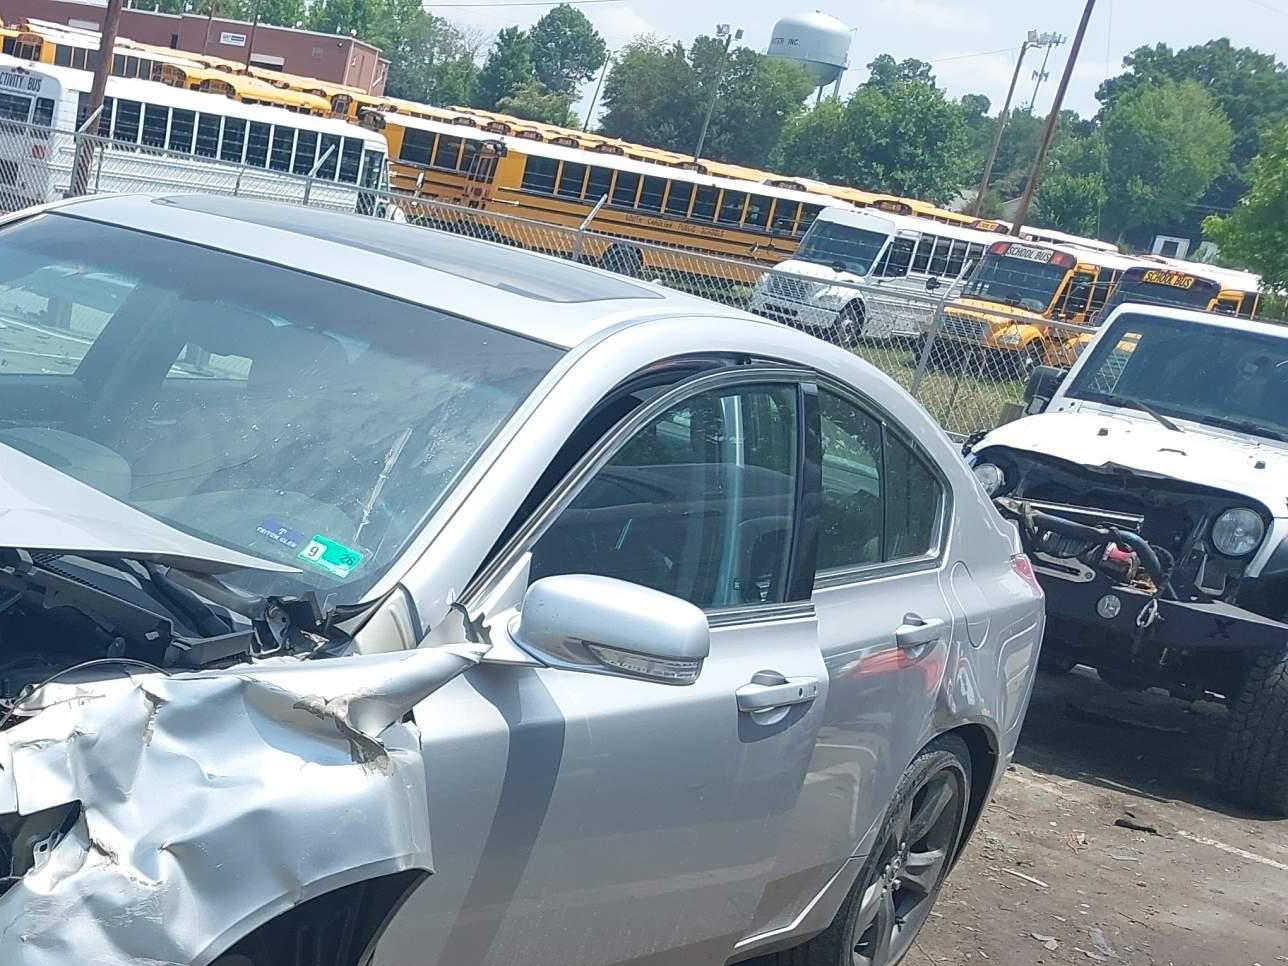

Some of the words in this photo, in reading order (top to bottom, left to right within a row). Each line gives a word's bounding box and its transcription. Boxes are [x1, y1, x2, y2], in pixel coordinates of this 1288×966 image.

[27, 76, 42, 92] BUS
[1006, 245, 1033, 259] SCHOOL
[1034, 250, 1052, 262] BUS
[1144, 271, 1172, 285] SCHOOL
[1174, 274, 1193, 288] BUS
[308, 546, 319, 557] 9
[340, 553, 356, 566] 26
